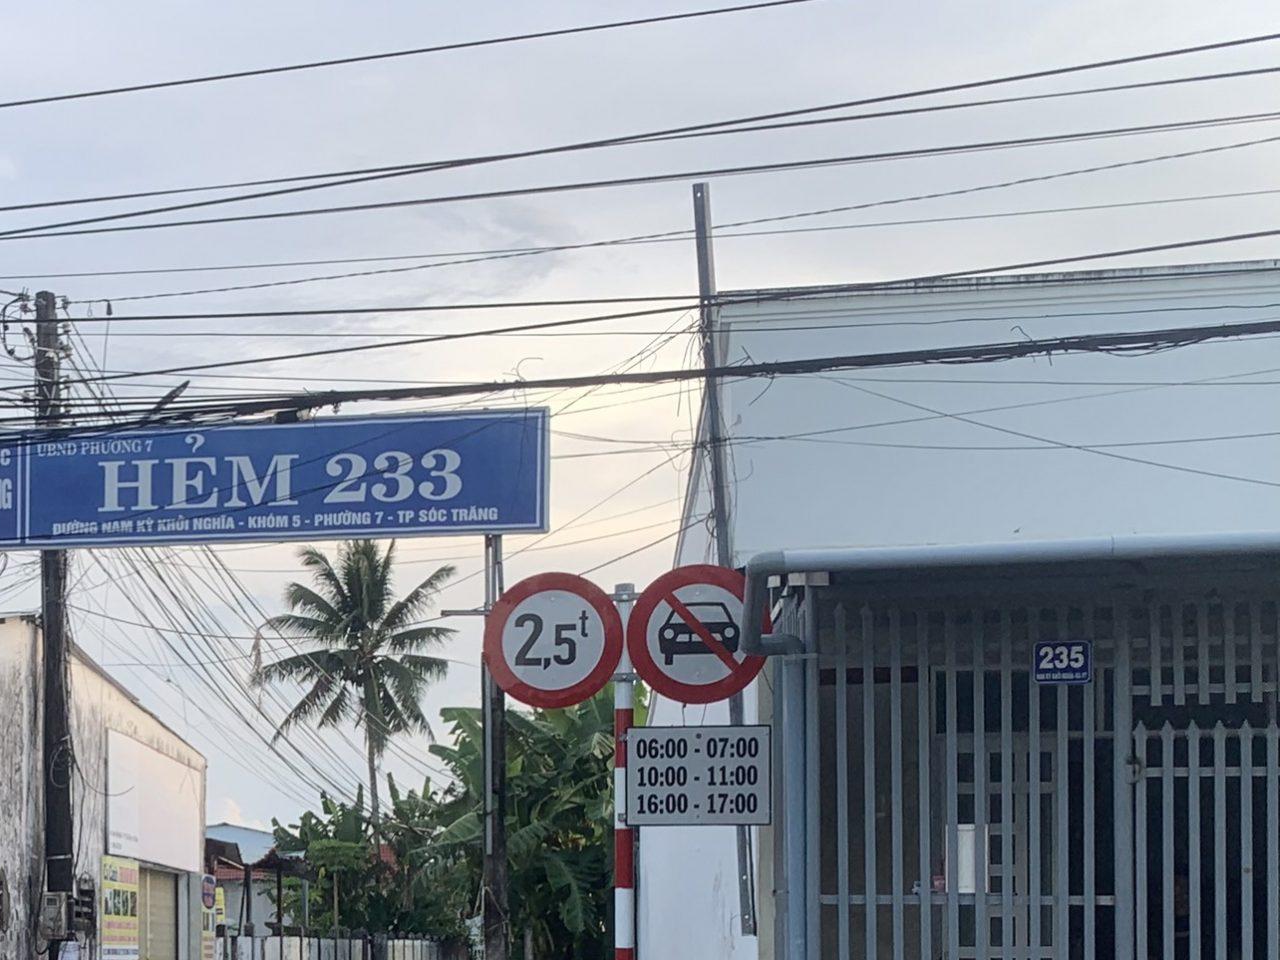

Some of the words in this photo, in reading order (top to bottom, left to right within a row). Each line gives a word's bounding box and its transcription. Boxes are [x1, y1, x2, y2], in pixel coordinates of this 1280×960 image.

[144, 440, 154, 453] 7
[97, 433, 300, 512] HẺM
[323, 448, 463, 504] 233
[101, 520, 132, 533] NAM
[193, 514, 235, 531] NGHĨA
[248, 513, 288, 529] KHÓM
[292, 516, 301, 528] 5
[314, 509, 371, 526] PHƯỜNG
[375, 512, 384, 524] 7
[397, 510, 415, 524] TP
[419, 506, 447, 523] SÓC
[452, 504, 498, 522] TRĂNG
[515, 613, 576, 670] 2,5
[1039, 646, 1085, 669] 235
[637, 738, 688, 759] 06:00
[706, 737, 759, 758] 07:00
[637, 766, 687, 787] 10:00
[707, 765, 758, 786] 11:00
[637, 793, 688, 814] 16:00
[707, 793, 758, 814] 17:00
